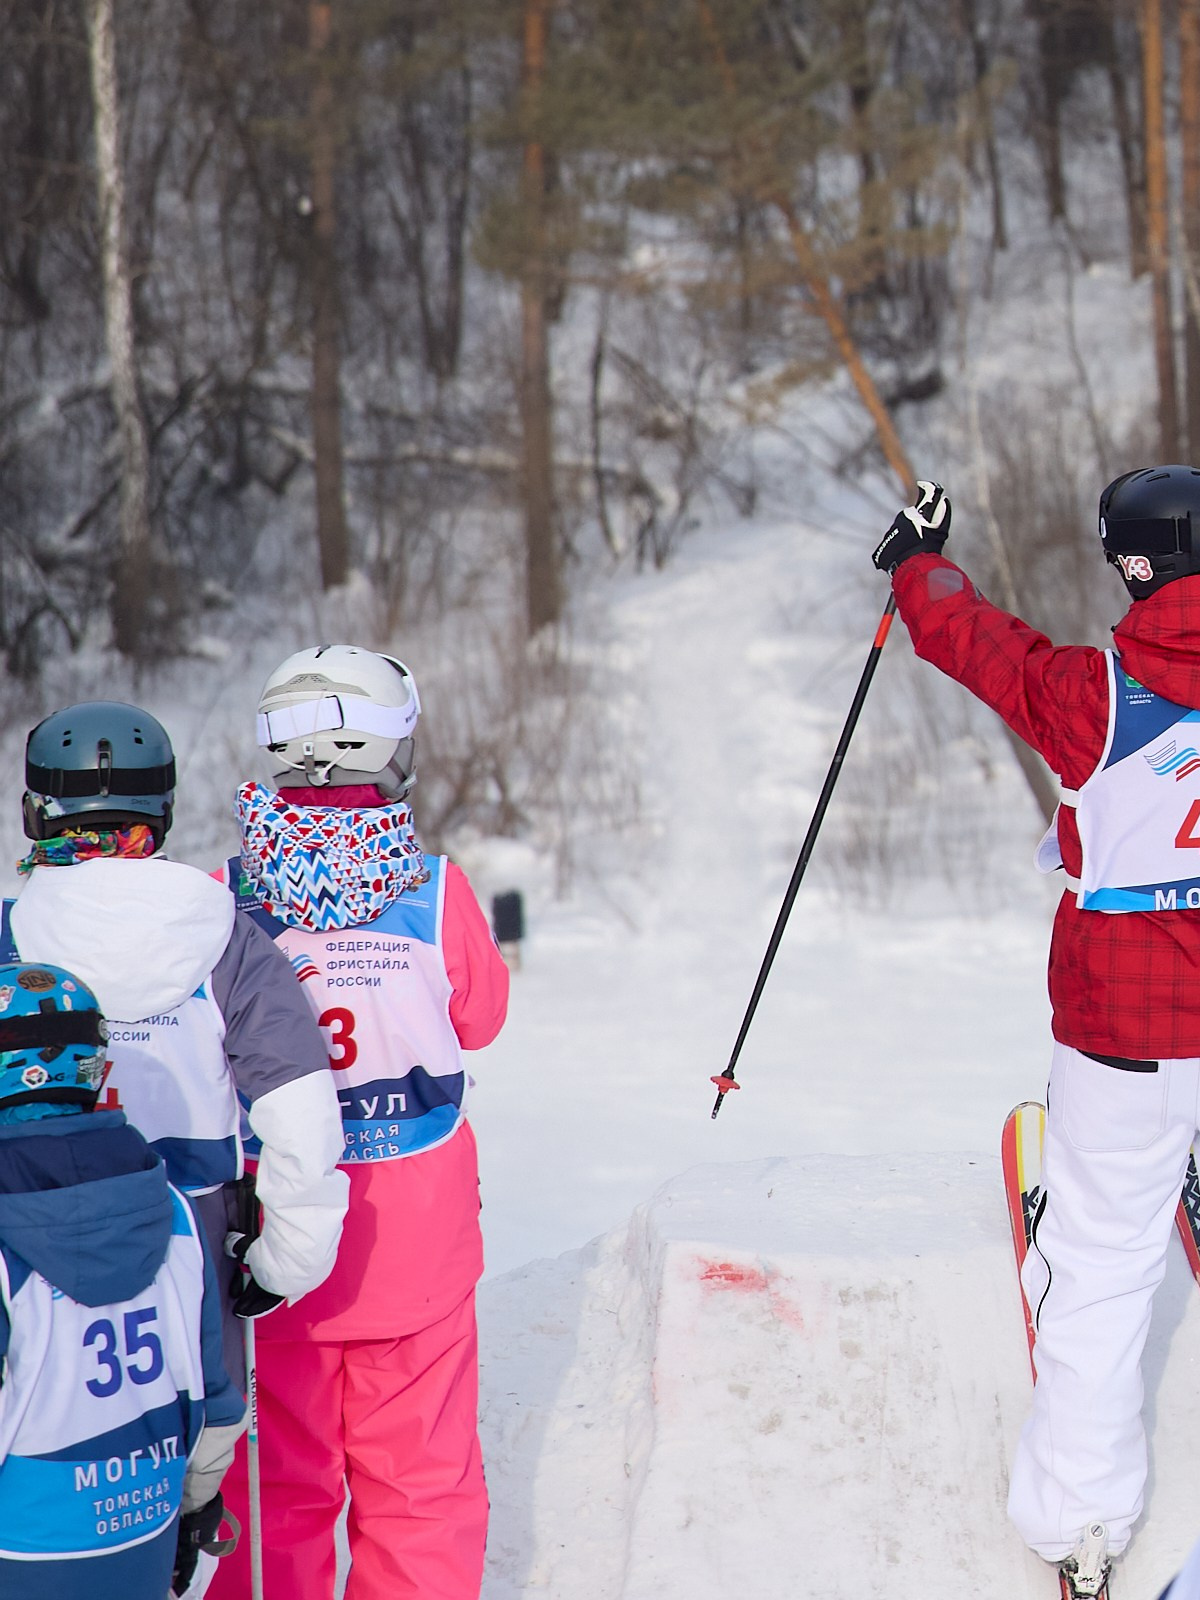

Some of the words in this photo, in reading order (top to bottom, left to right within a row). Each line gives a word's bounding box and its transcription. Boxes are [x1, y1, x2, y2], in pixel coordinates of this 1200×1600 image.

[325, 941, 411, 953] ФЕДЕРАЦИЯ
[326, 957, 410, 970] ФРИСТАЙЛА
[327, 976, 382, 988] РОССИИ
[318, 1007, 358, 1070] 3
[345, 1124, 399, 1144] СКАЯ
[348, 1142, 399, 1160] АСТЬ
[83, 1306, 165, 1398] 35
[74, 1435, 178, 1492] МОГУЛ
[93, 1477, 171, 1516] ТОМСКАЯ
[96, 1500, 172, 1536] ОБЛАСТЬ
